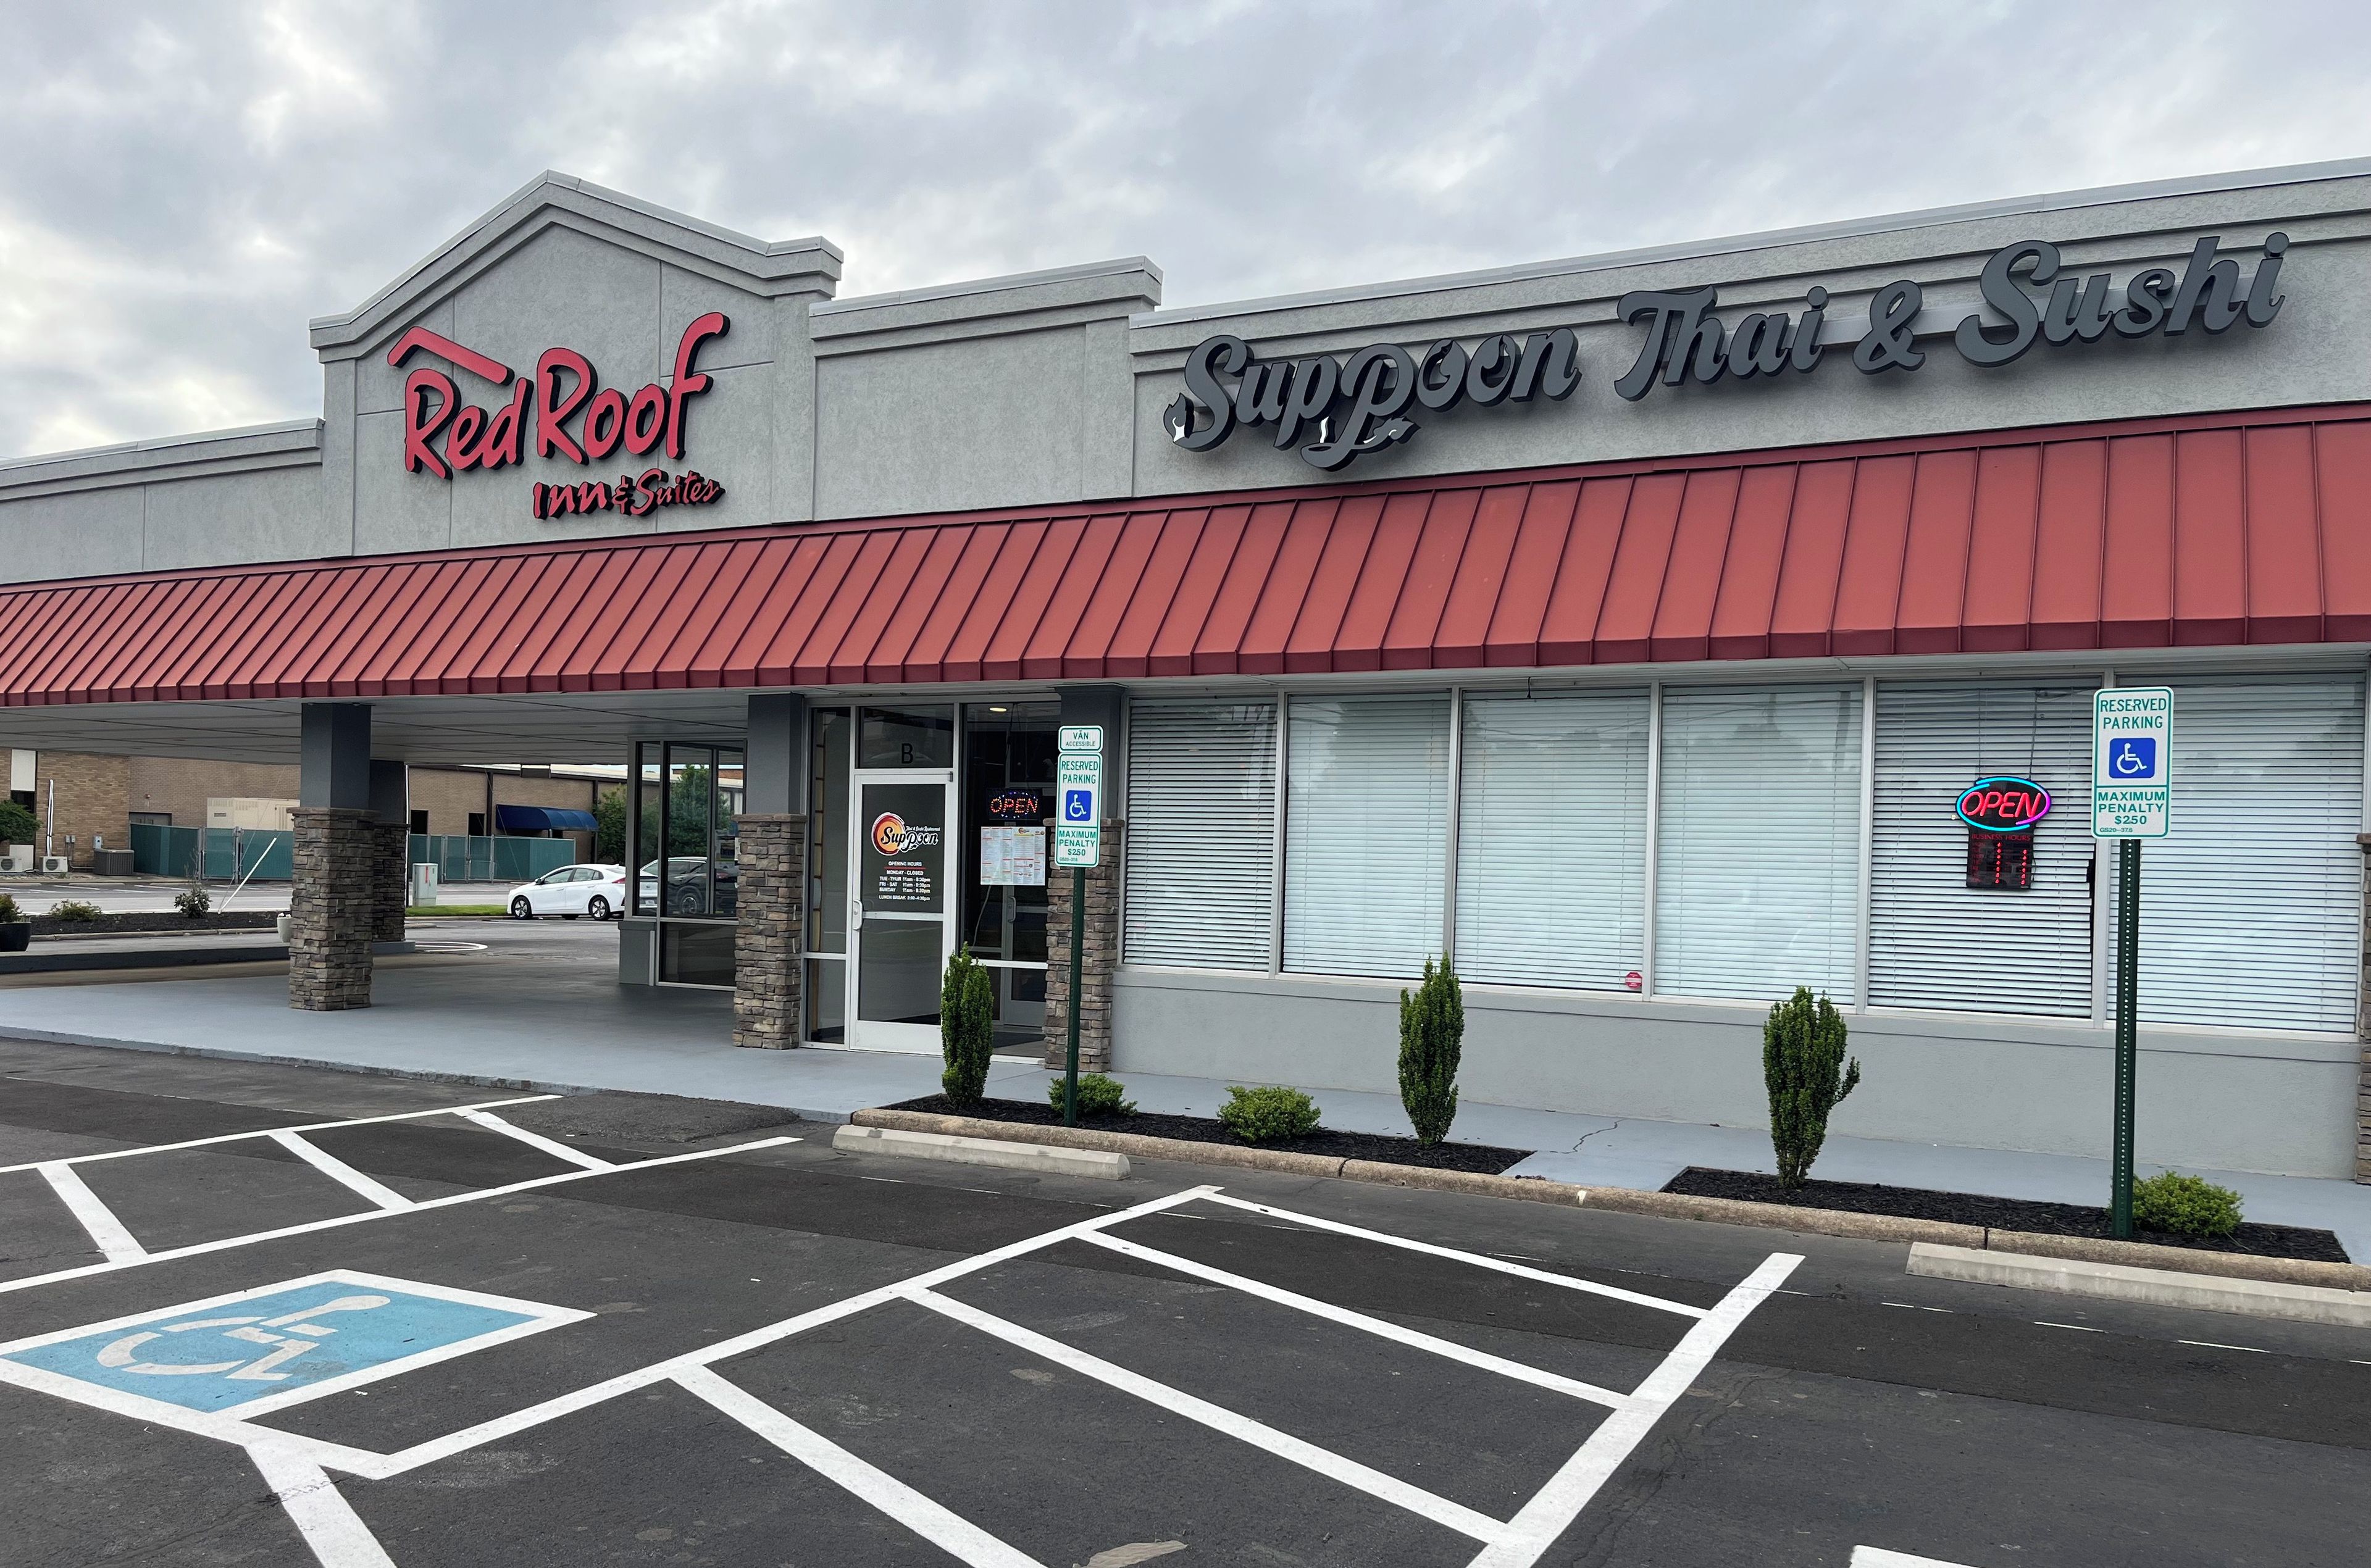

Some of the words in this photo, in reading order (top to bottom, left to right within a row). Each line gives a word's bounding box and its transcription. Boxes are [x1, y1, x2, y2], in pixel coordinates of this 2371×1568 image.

[1613, 284, 1830, 402] Thai
[1852, 279, 1926, 375] &
[1955, 231, 2290, 369] Sushi
[404, 367, 534, 480] Red
[536, 311, 730, 466] Roof
[533, 481, 612, 520] Inn
[630, 467, 726, 517] Suites
[2100, 698, 2167, 712] RESERVED
[2103, 715, 2163, 729] PARKING
[1073, 732, 1089, 740] VAN
[901, 743, 914, 764] B
[1061, 761, 1098, 771] RESERVED
[1063, 774, 1096, 784] PARKING
[2098, 791, 2165, 802] MAXIMUM
[990, 798, 1038, 814] OPEN
[1962, 791, 2041, 818] OPEN
[2099, 803, 2164, 813] PENALTY
[2114, 815, 2147, 825] $250
[1059, 830, 1096, 838] MAXIMUM
[1059, 839, 1095, 848] PENALTY
[1068, 848, 1086, 856] $250
